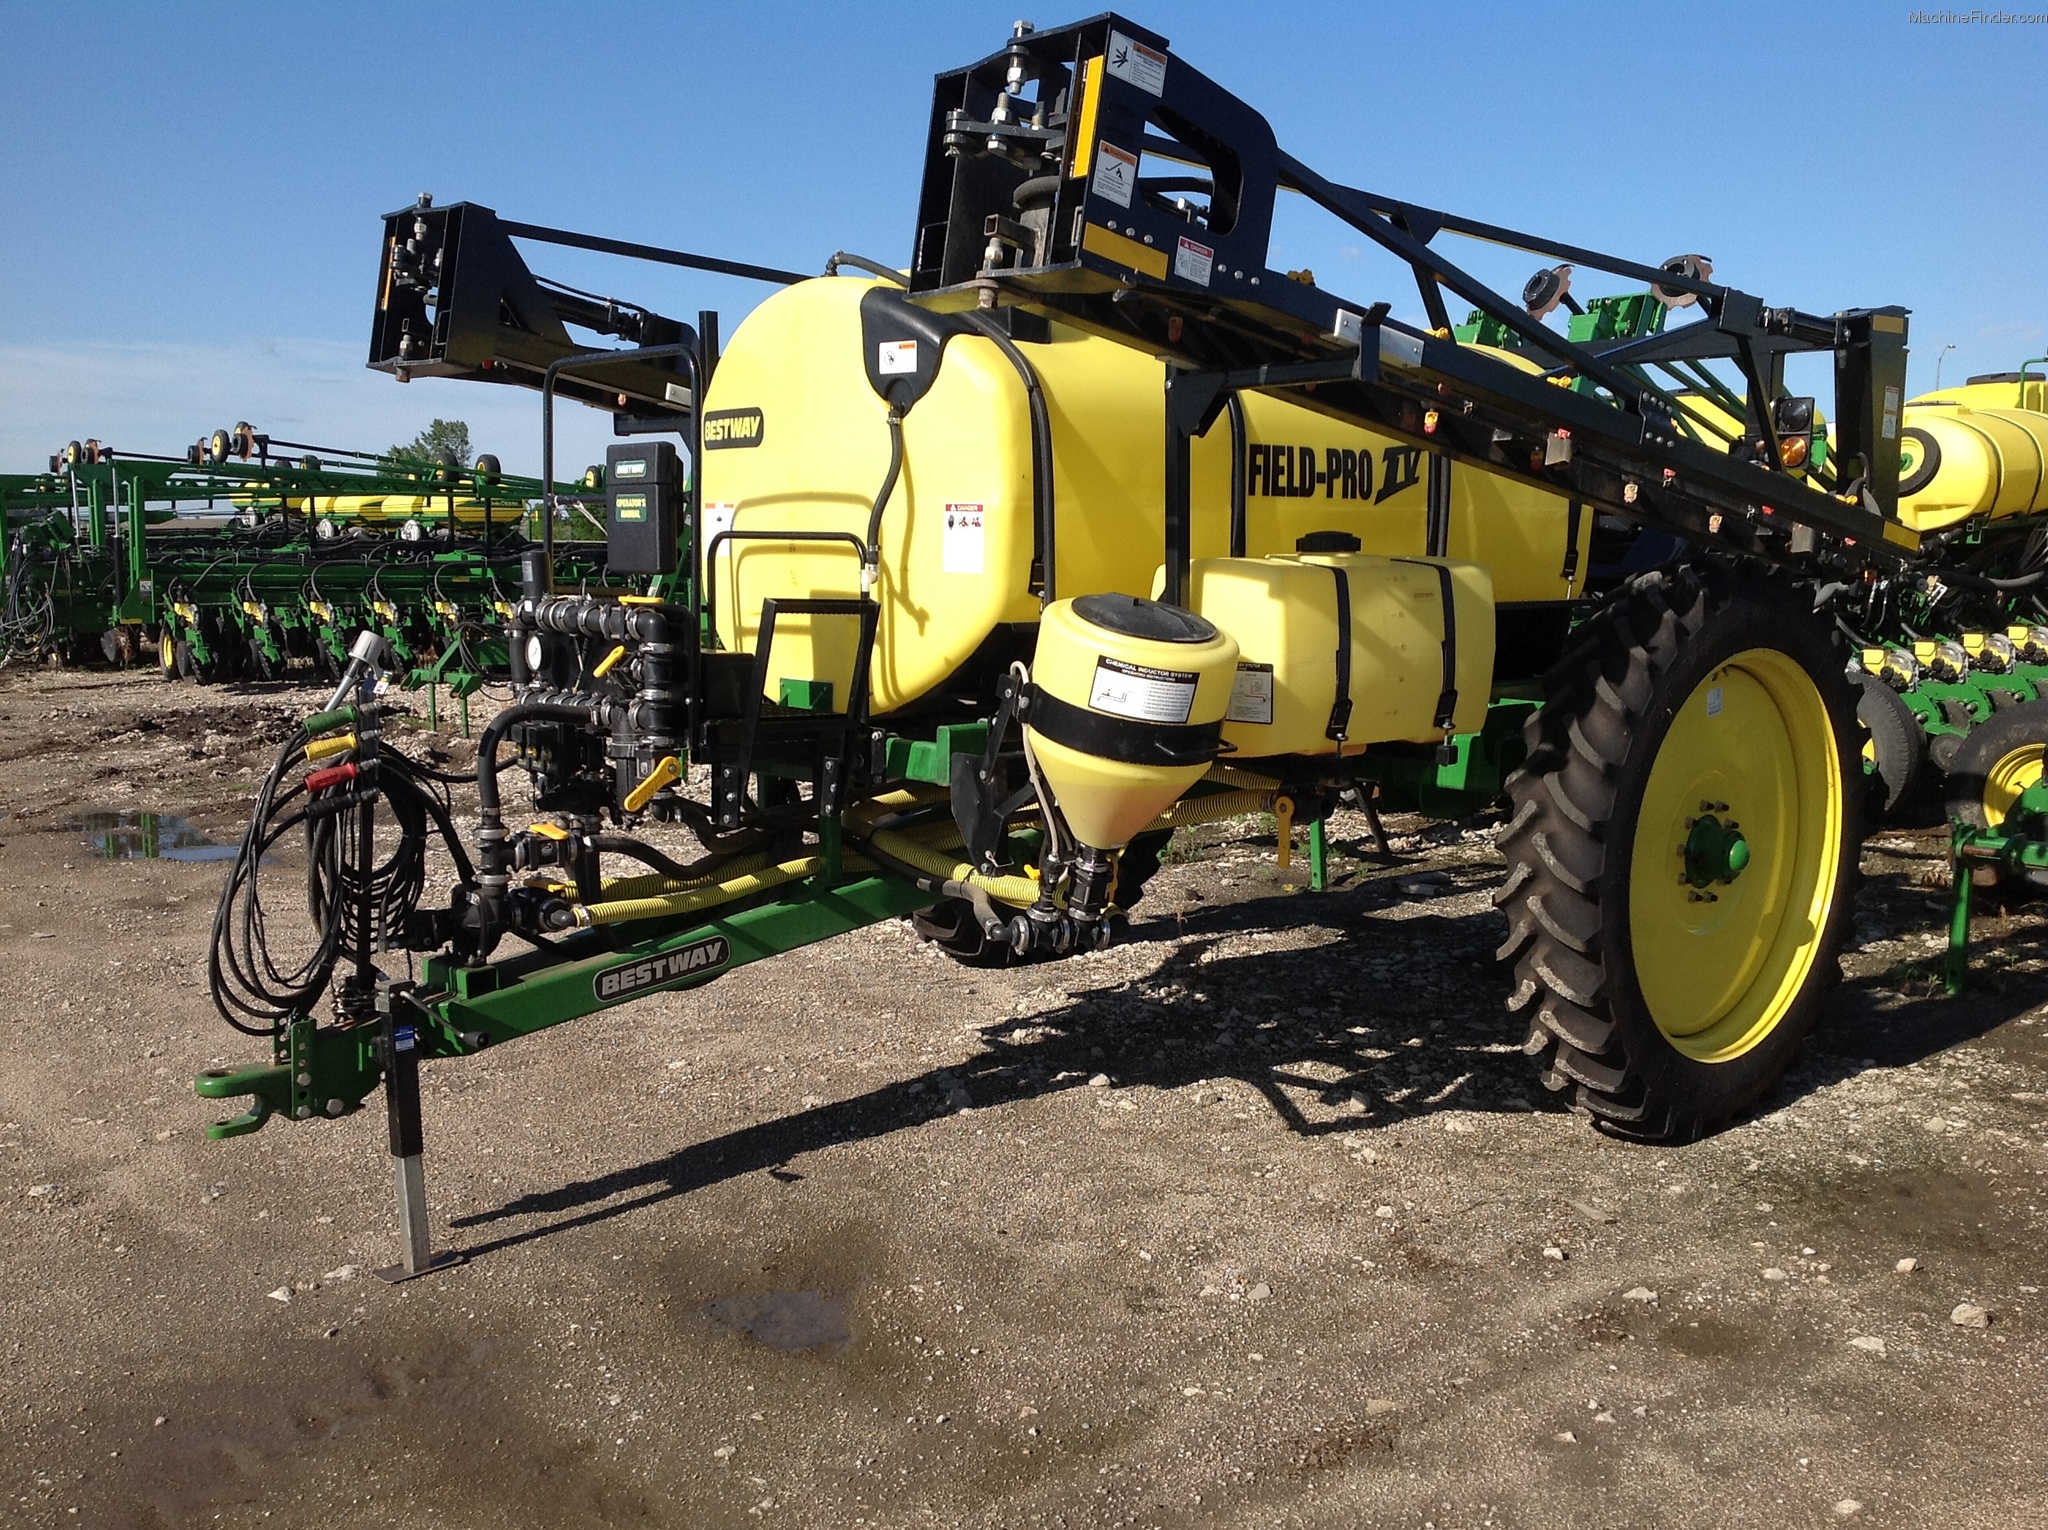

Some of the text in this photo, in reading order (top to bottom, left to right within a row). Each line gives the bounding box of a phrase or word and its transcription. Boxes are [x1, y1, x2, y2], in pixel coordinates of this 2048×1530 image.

[1110, 149, 1134, 166] WARNING
[1190, 243, 1209, 256] DANGER
[705, 416, 760, 441] BESTWAY
[616, 464, 646, 475] BESTWAY
[1248, 444, 1373, 500] FIELD-PRO
[616, 498, 646, 508] OPERATOR'S
[620, 509, 641, 519] MANUAL
[1105, 658, 1137, 672] CHEMICAL
[1138, 666, 1170, 677] INDUCTOR
[1121, 669, 1146, 678] OPERATING
[602, 941, 722, 996] BESTWAY
